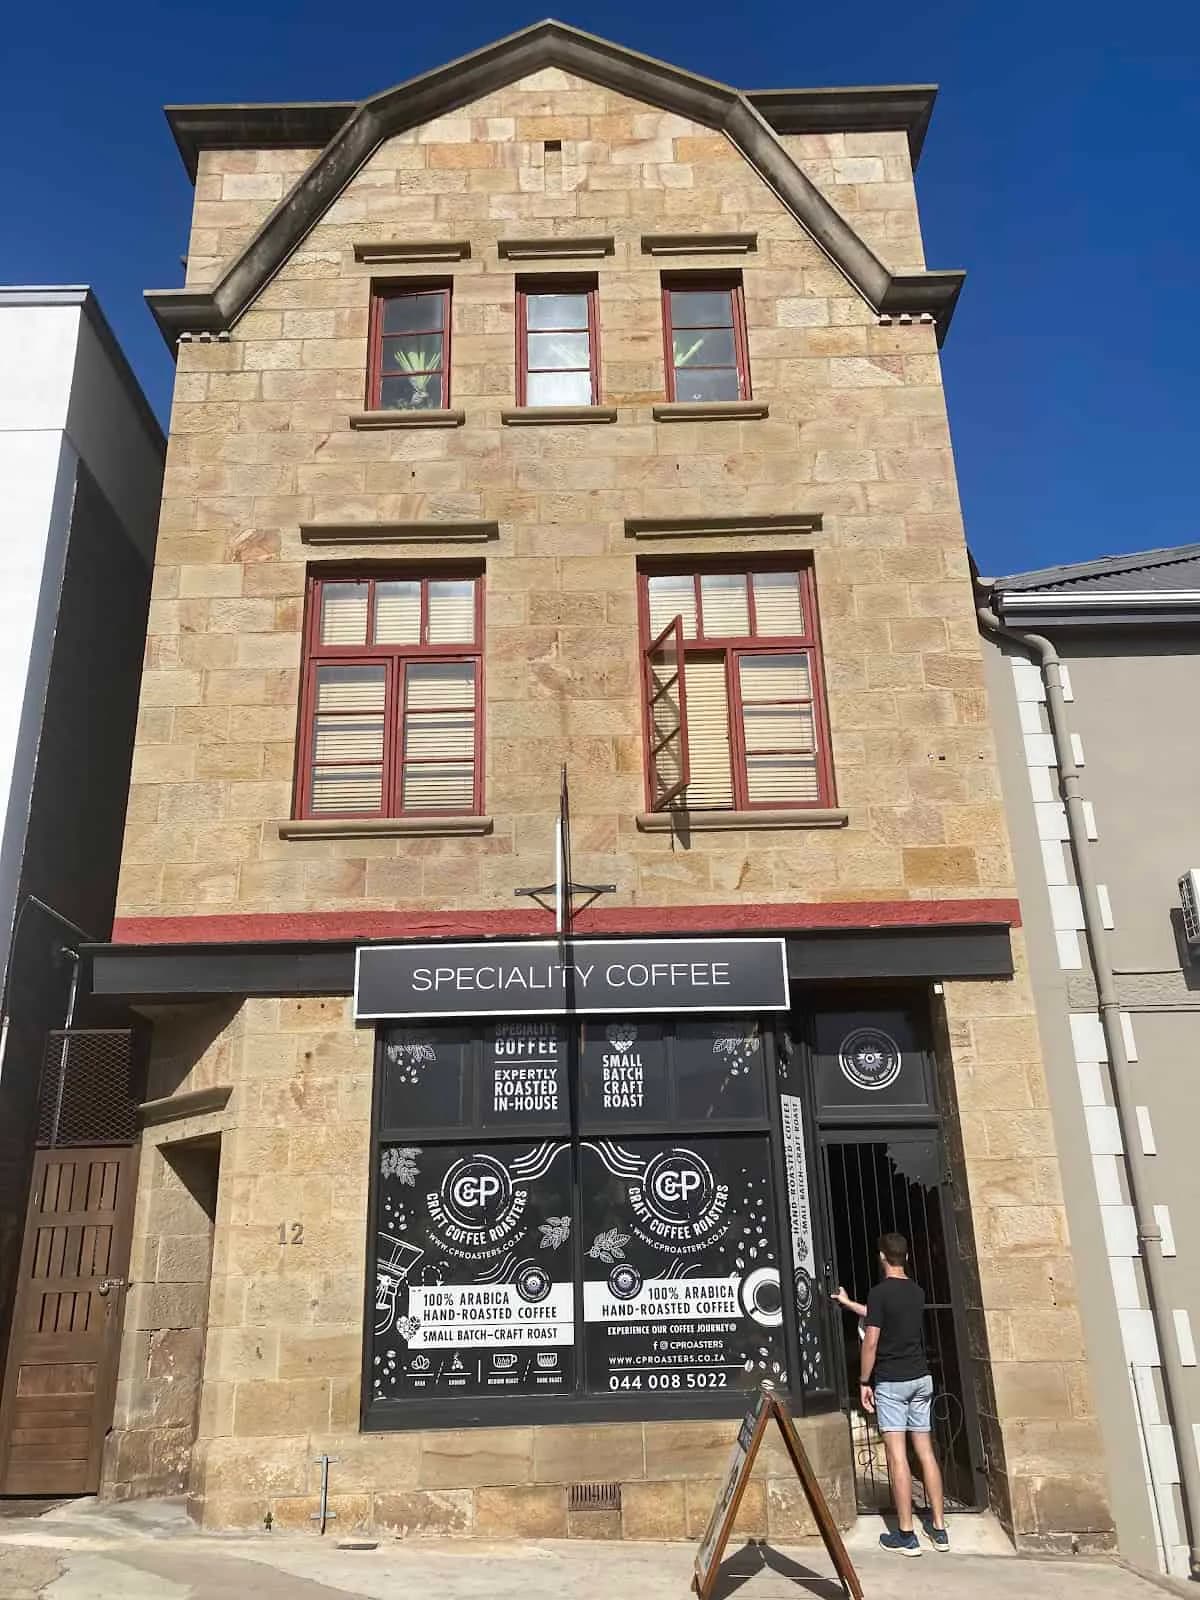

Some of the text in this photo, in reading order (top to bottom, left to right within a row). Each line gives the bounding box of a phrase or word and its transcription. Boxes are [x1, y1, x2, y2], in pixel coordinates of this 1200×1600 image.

[412, 963, 731, 991] SPECIALITY COFFEE
[495, 1037, 558, 1055] COFFEE
[602, 1054, 643, 1067] SMALL
[494, 1068, 557, 1081] EXPERTLY
[602, 1067, 643, 1081] BATCH
[494, 1080, 558, 1096] ROASTED
[603, 1080, 643, 1094] CRAFT
[494, 1096, 558, 1112] IN-HOUSE
[603, 1094, 643, 1108] ROAST
[426, 1190, 528, 1246] CRAFT COFFEE ROASTERS
[628, 1184, 729, 1240] CRAFT COFFEE ROASTERS
[277, 1222, 304, 1245] 12
[423, 1292, 510, 1307] 100% ARABICA
[648, 1285, 735, 1301] 100% ARABICA
[423, 1306, 557, 1321] HAND-ROASTED COFFEE
[602, 1301, 736, 1317] HAND-ROASTED COFFEE
[423, 1329, 454, 1342] SMALL
[527, 1327, 558, 1340] ROAST
[607, 1325, 650, 1336] EXPERIENCE
[651, 1324, 667, 1334] OUR
[669, 1324, 695, 1334] COFFEE
[669, 1340, 724, 1350] CPROASTERS
[608, 1354, 726, 1365] WWW.CPROASTERS.CO.ZA
[609, 1372, 728, 1390] 044 008 5022
